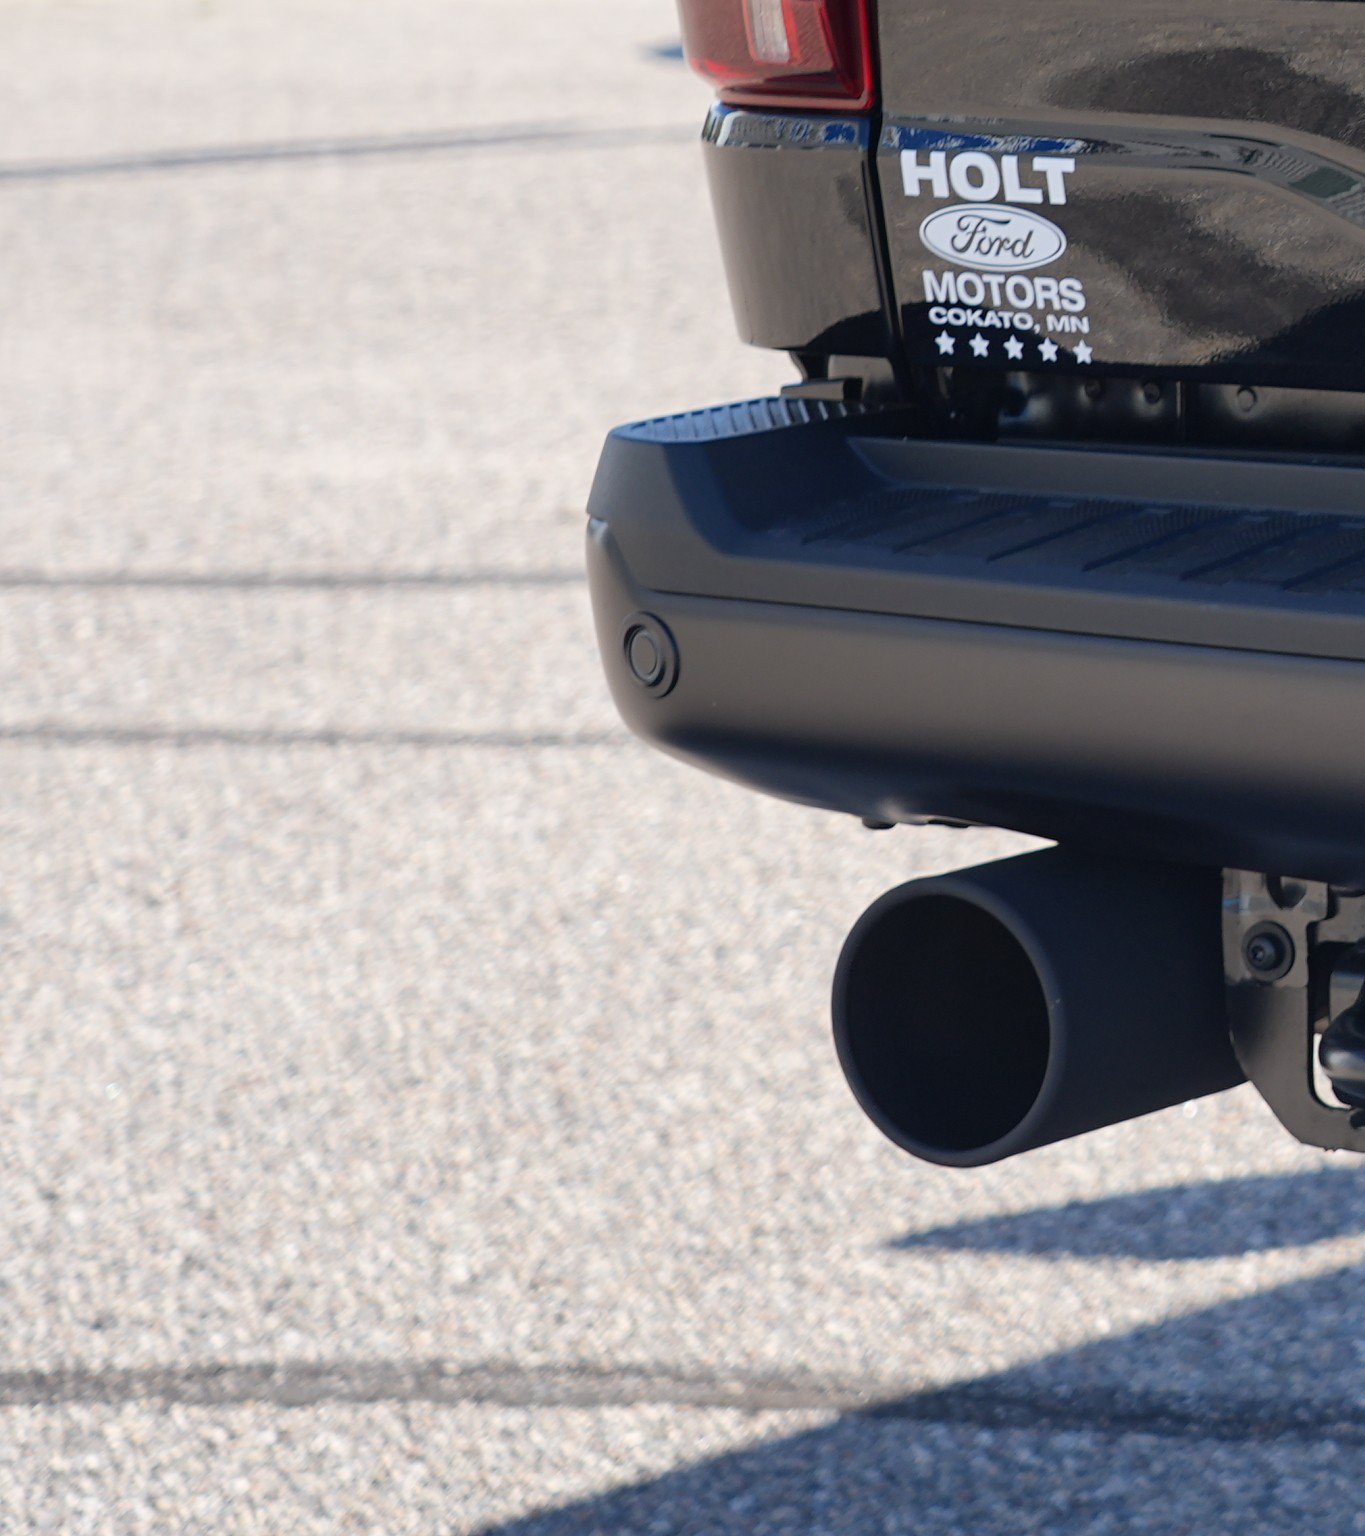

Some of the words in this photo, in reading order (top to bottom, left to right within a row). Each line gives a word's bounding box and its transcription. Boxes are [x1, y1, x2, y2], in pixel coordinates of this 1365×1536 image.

[900, 149, 1076, 205] HOLT
[951, 214, 1034, 259] Ford
[922, 269, 1086, 313] MOTORS
[928, 306, 1041, 334] COKATO,
[1047, 314, 1090, 334] MN
